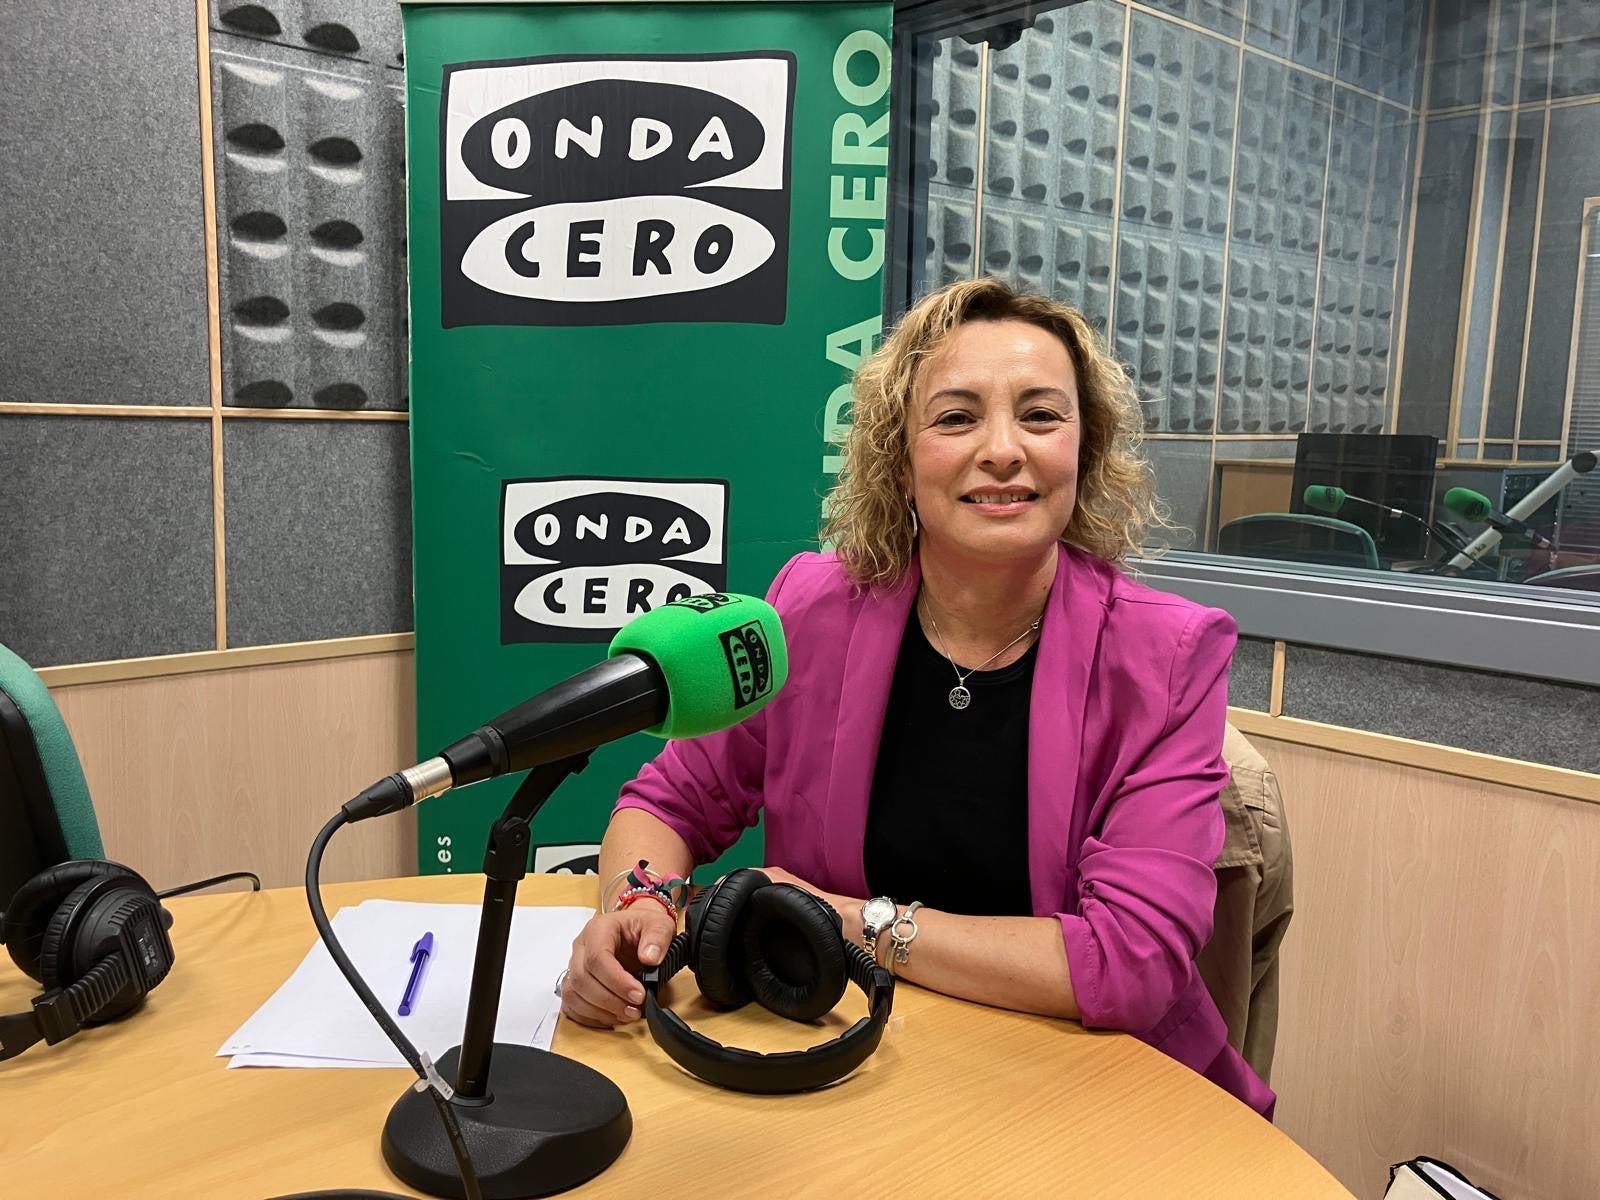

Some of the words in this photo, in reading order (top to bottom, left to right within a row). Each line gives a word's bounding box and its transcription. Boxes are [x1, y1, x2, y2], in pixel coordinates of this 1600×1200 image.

[490, 115, 734, 169] ONDA
[827, 30, 891, 281] CERO
[504, 219, 733, 278] CERO
[533, 513, 692, 546] ONDA
[733, 642, 752, 695] CERO
[749, 633, 766, 687] ONDA
